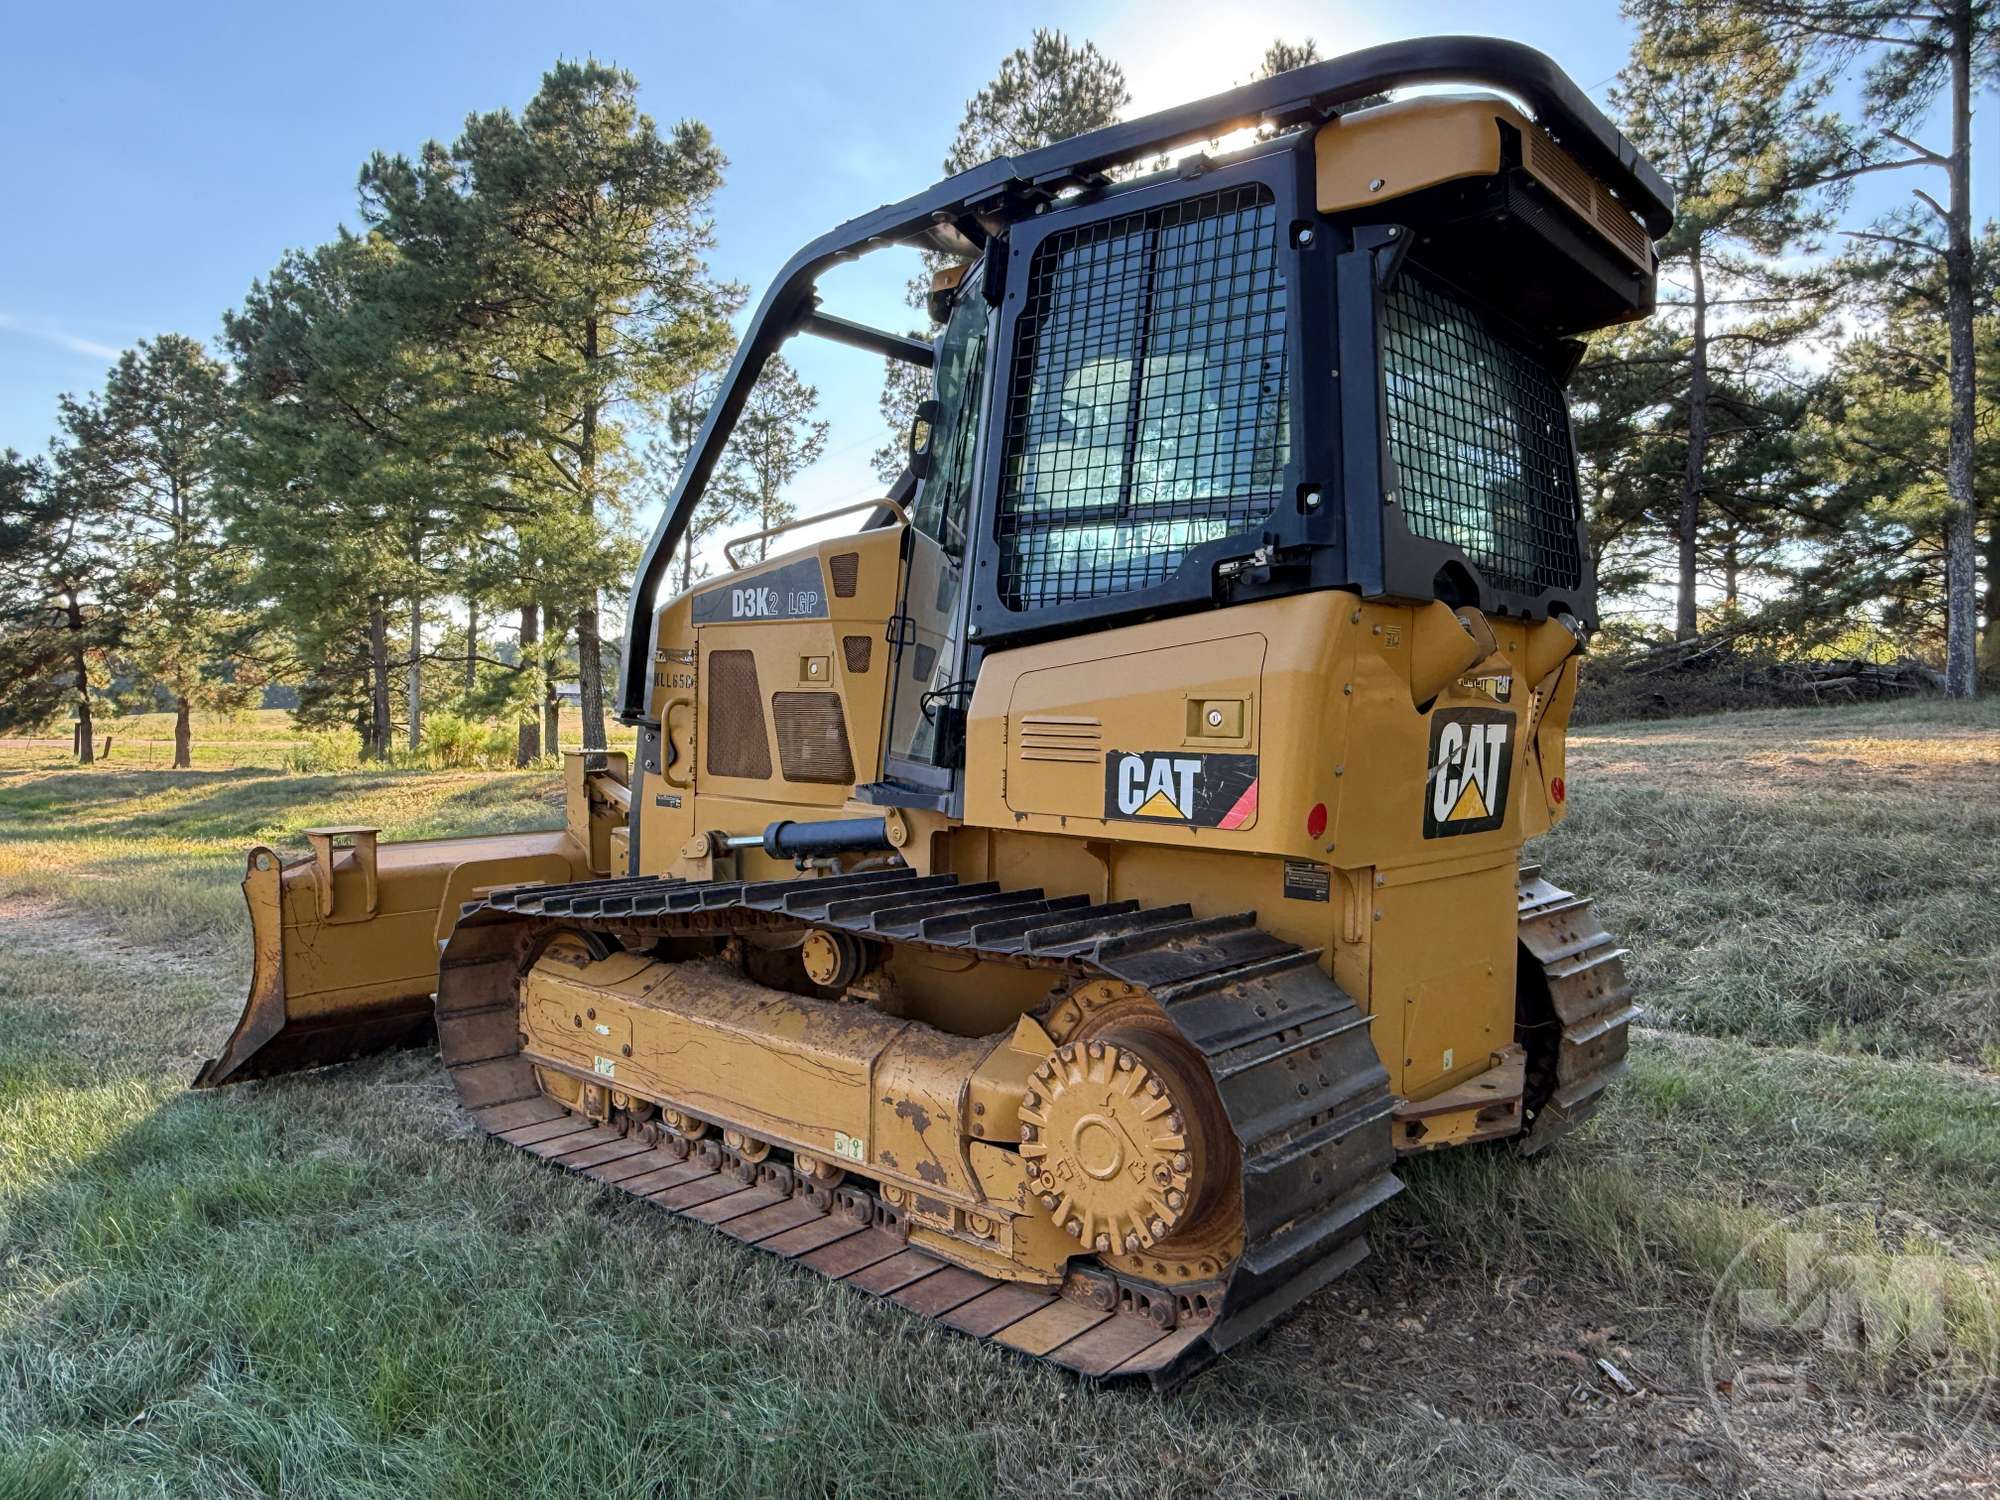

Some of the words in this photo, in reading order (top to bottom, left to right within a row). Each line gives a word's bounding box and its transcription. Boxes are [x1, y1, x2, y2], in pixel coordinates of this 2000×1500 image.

[732, 587, 778, 617] D3K2
[788, 591, 818, 614] LGP
[1118, 756, 1202, 820] CAT
[1433, 722, 1508, 822] CAT
